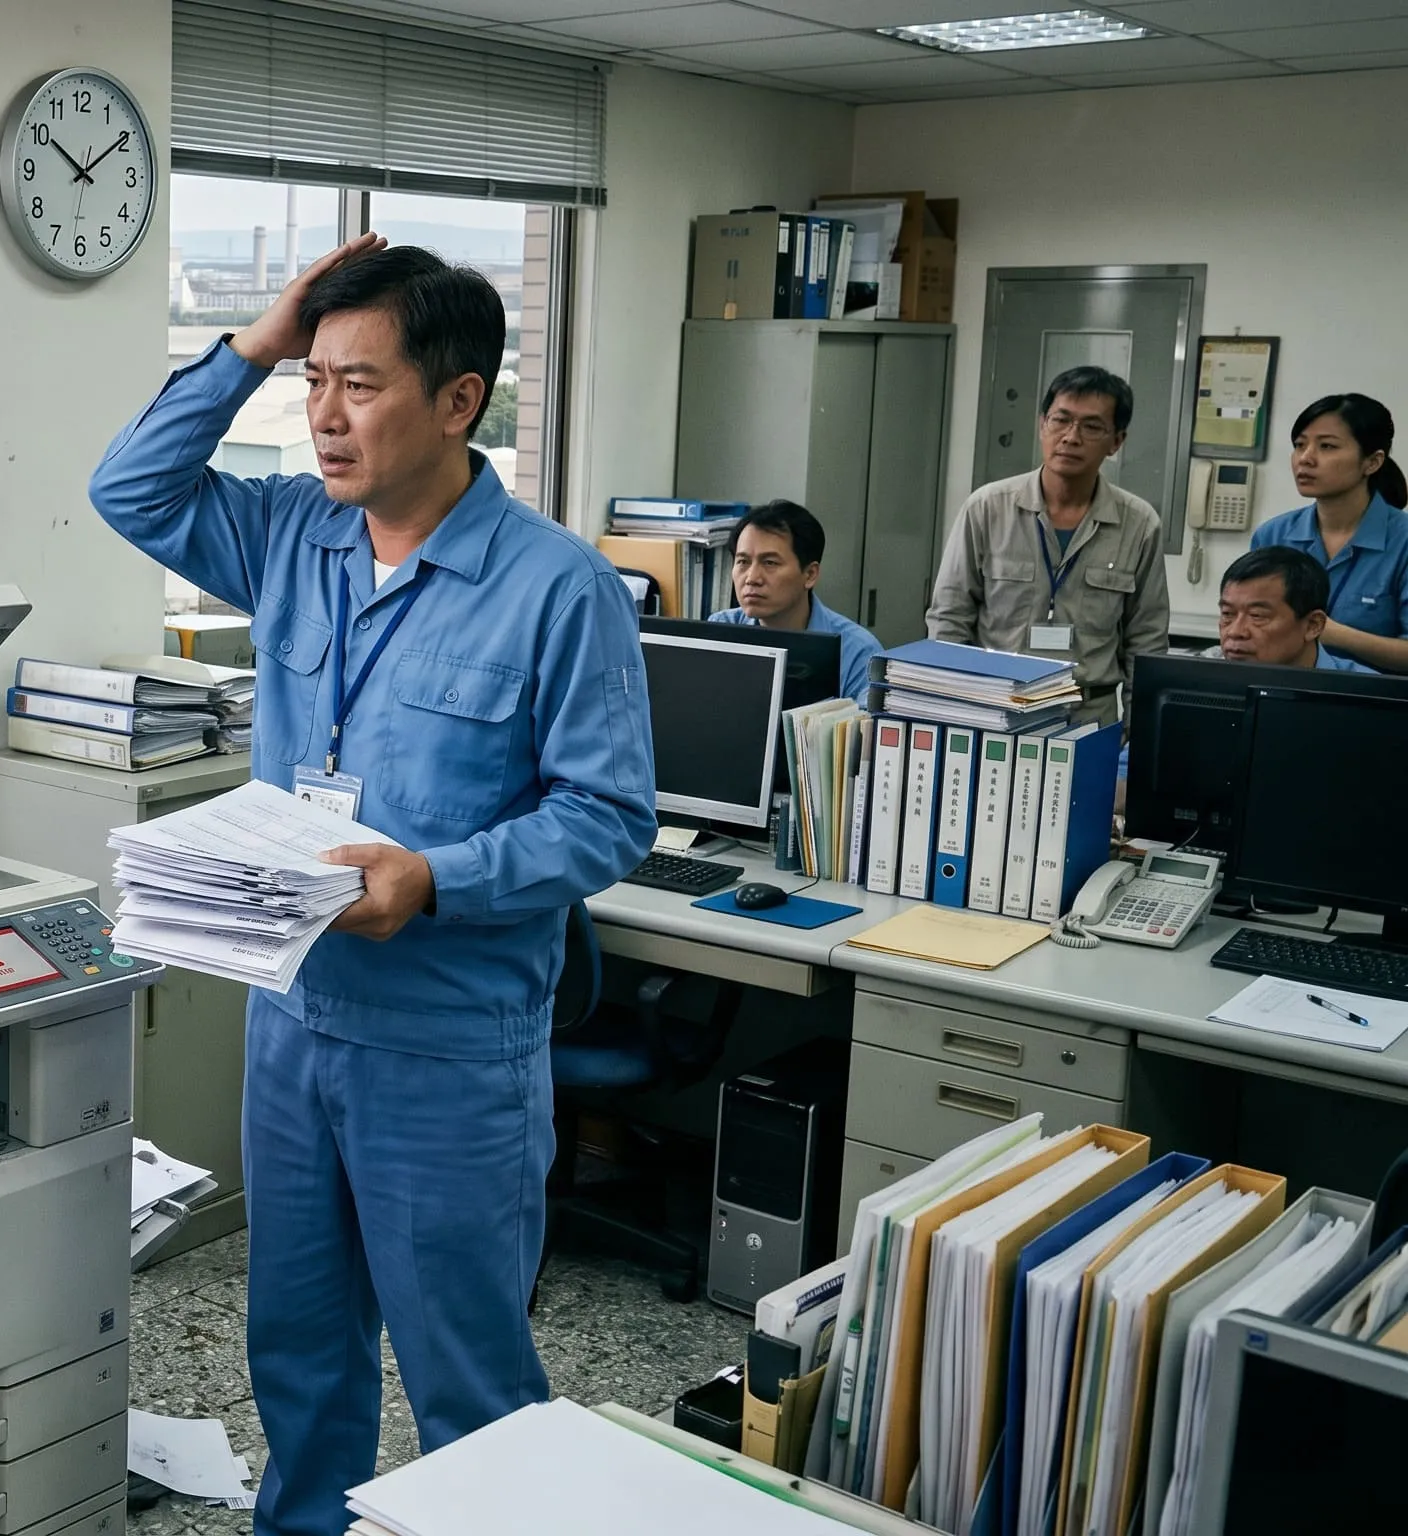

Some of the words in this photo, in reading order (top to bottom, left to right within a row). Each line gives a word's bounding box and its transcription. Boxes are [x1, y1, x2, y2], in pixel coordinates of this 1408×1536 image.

[49, 98, 63, 120] 11
[72, 91, 91, 113] 12
[103, 103, 110, 124] 1
[30, 123, 49, 146] 10
[23, 158, 35, 181] 9
[125, 167, 136, 188] 3
[31, 196, 43, 218] 8
[117, 202, 129, 223] 4
[49, 224, 61, 246] 7
[74, 235, 86, 257] 6
[99, 226, 111, 247] 5
